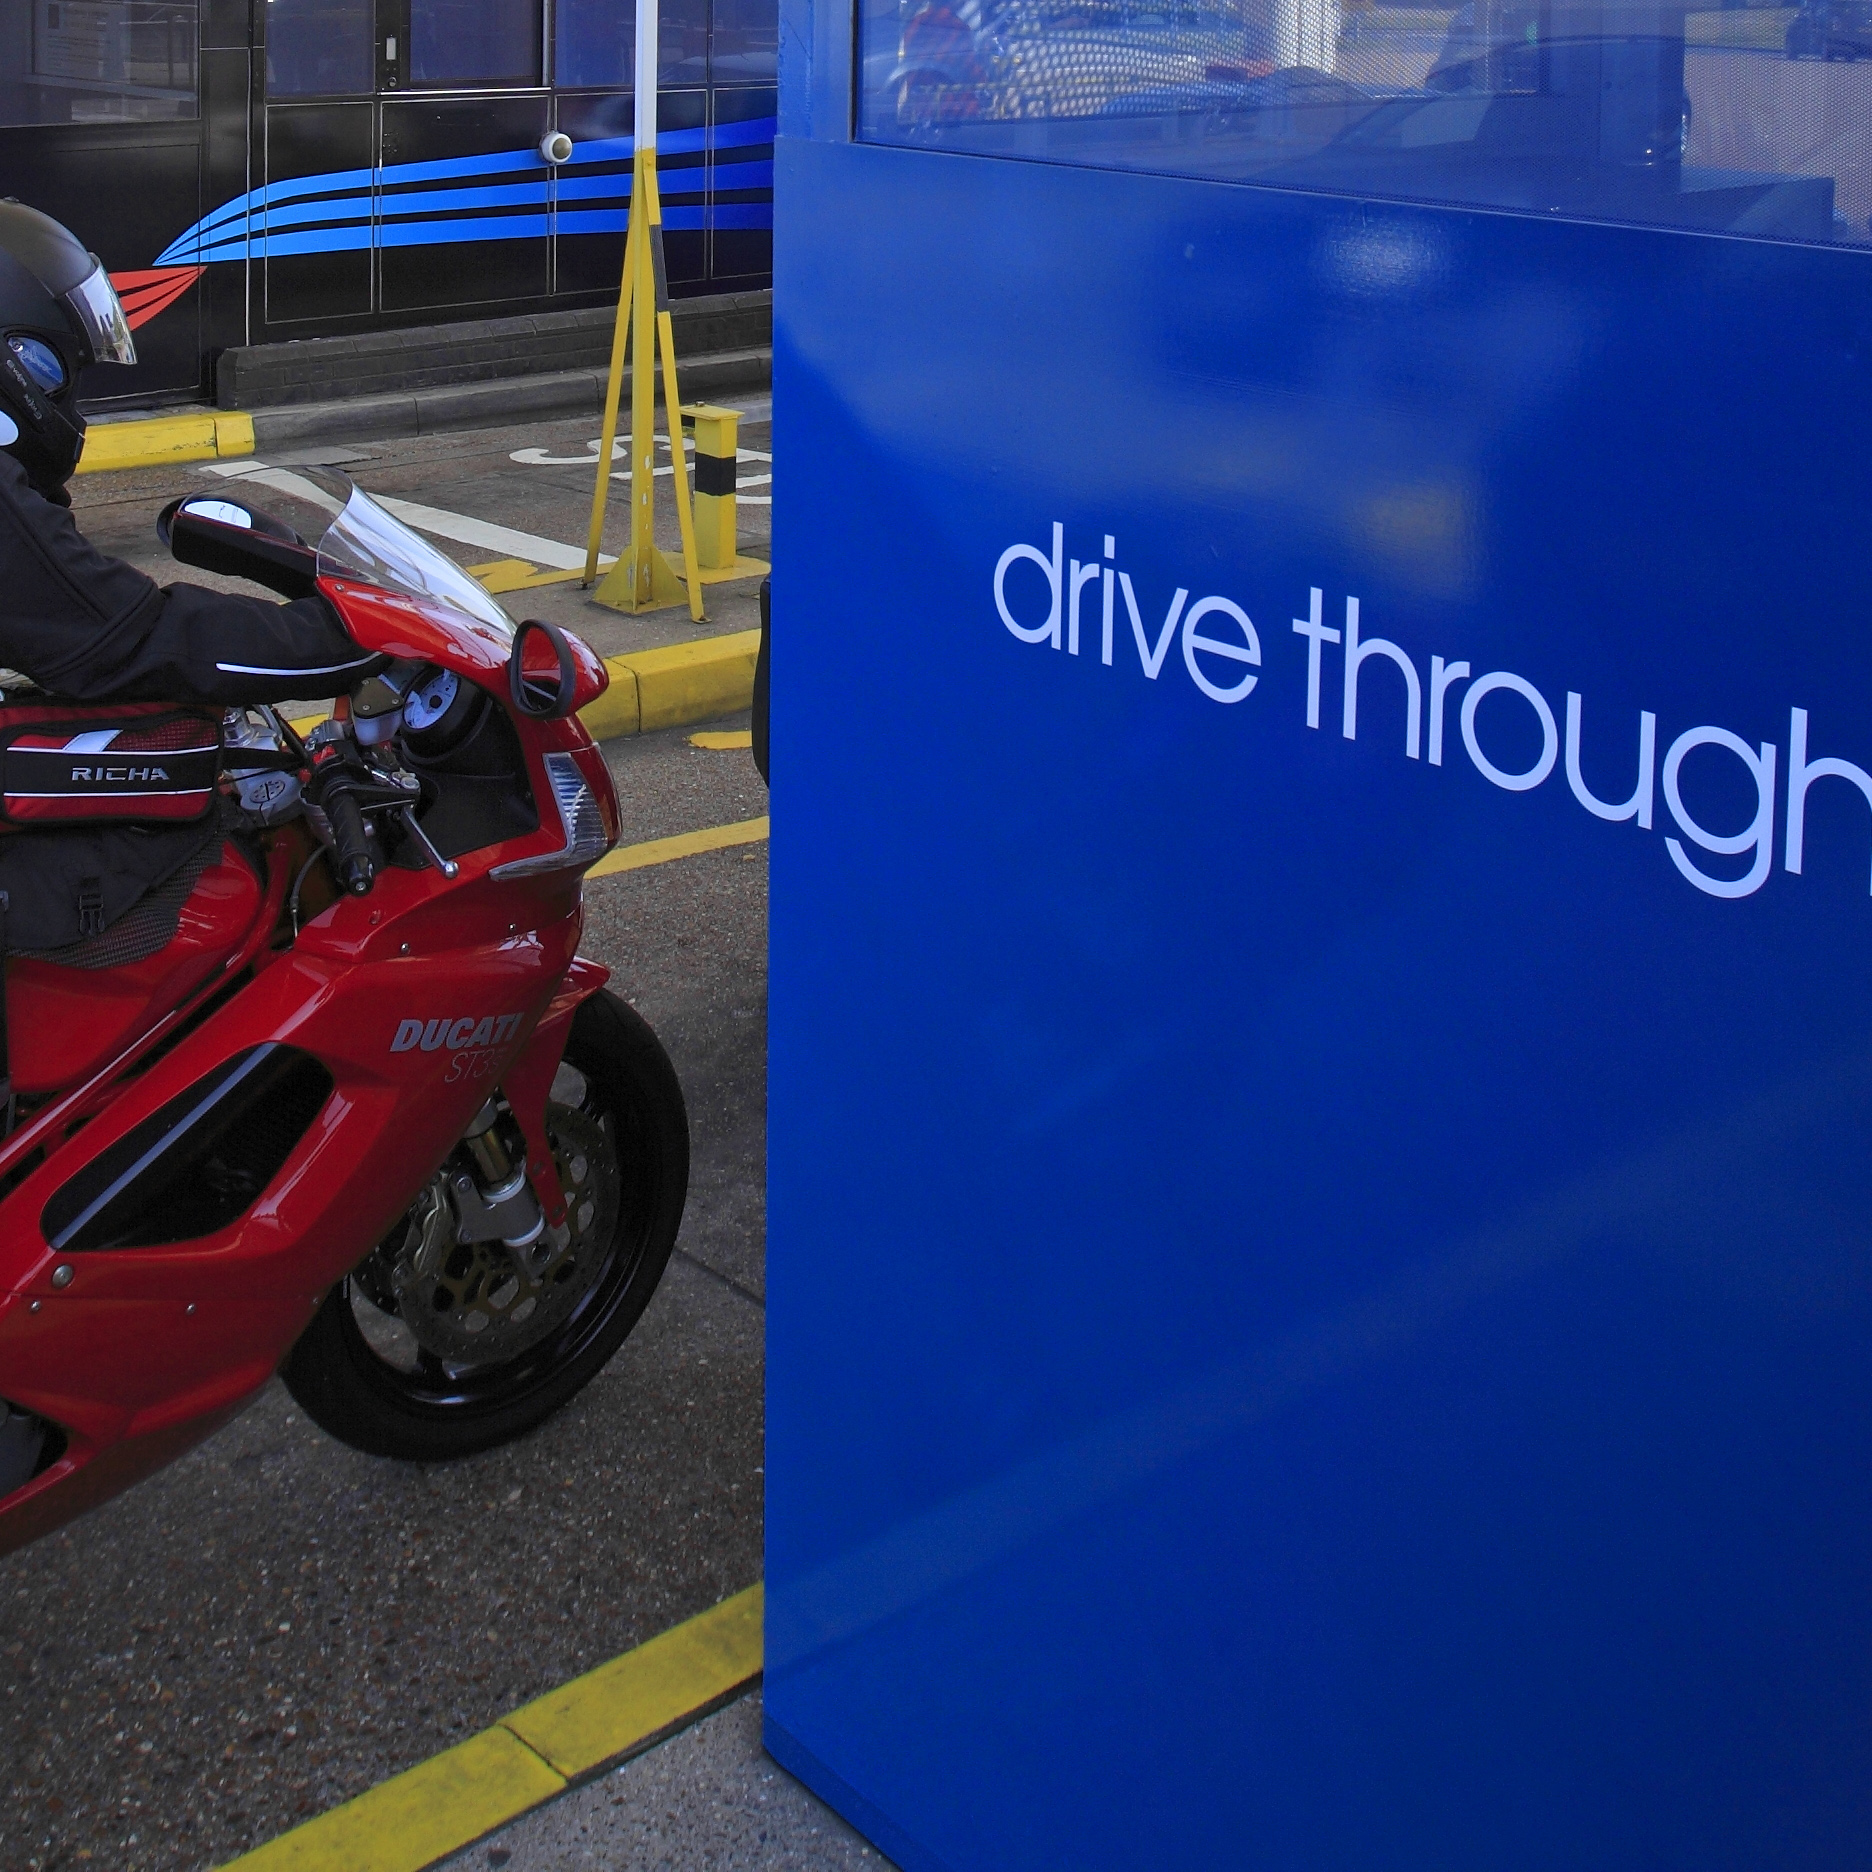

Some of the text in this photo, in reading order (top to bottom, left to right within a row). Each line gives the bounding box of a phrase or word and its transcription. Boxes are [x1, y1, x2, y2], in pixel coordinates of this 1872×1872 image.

[993, 523, 1262, 704] drive
[71, 767, 170, 781] RICHA
[389, 1012, 525, 1053] DUCATI
